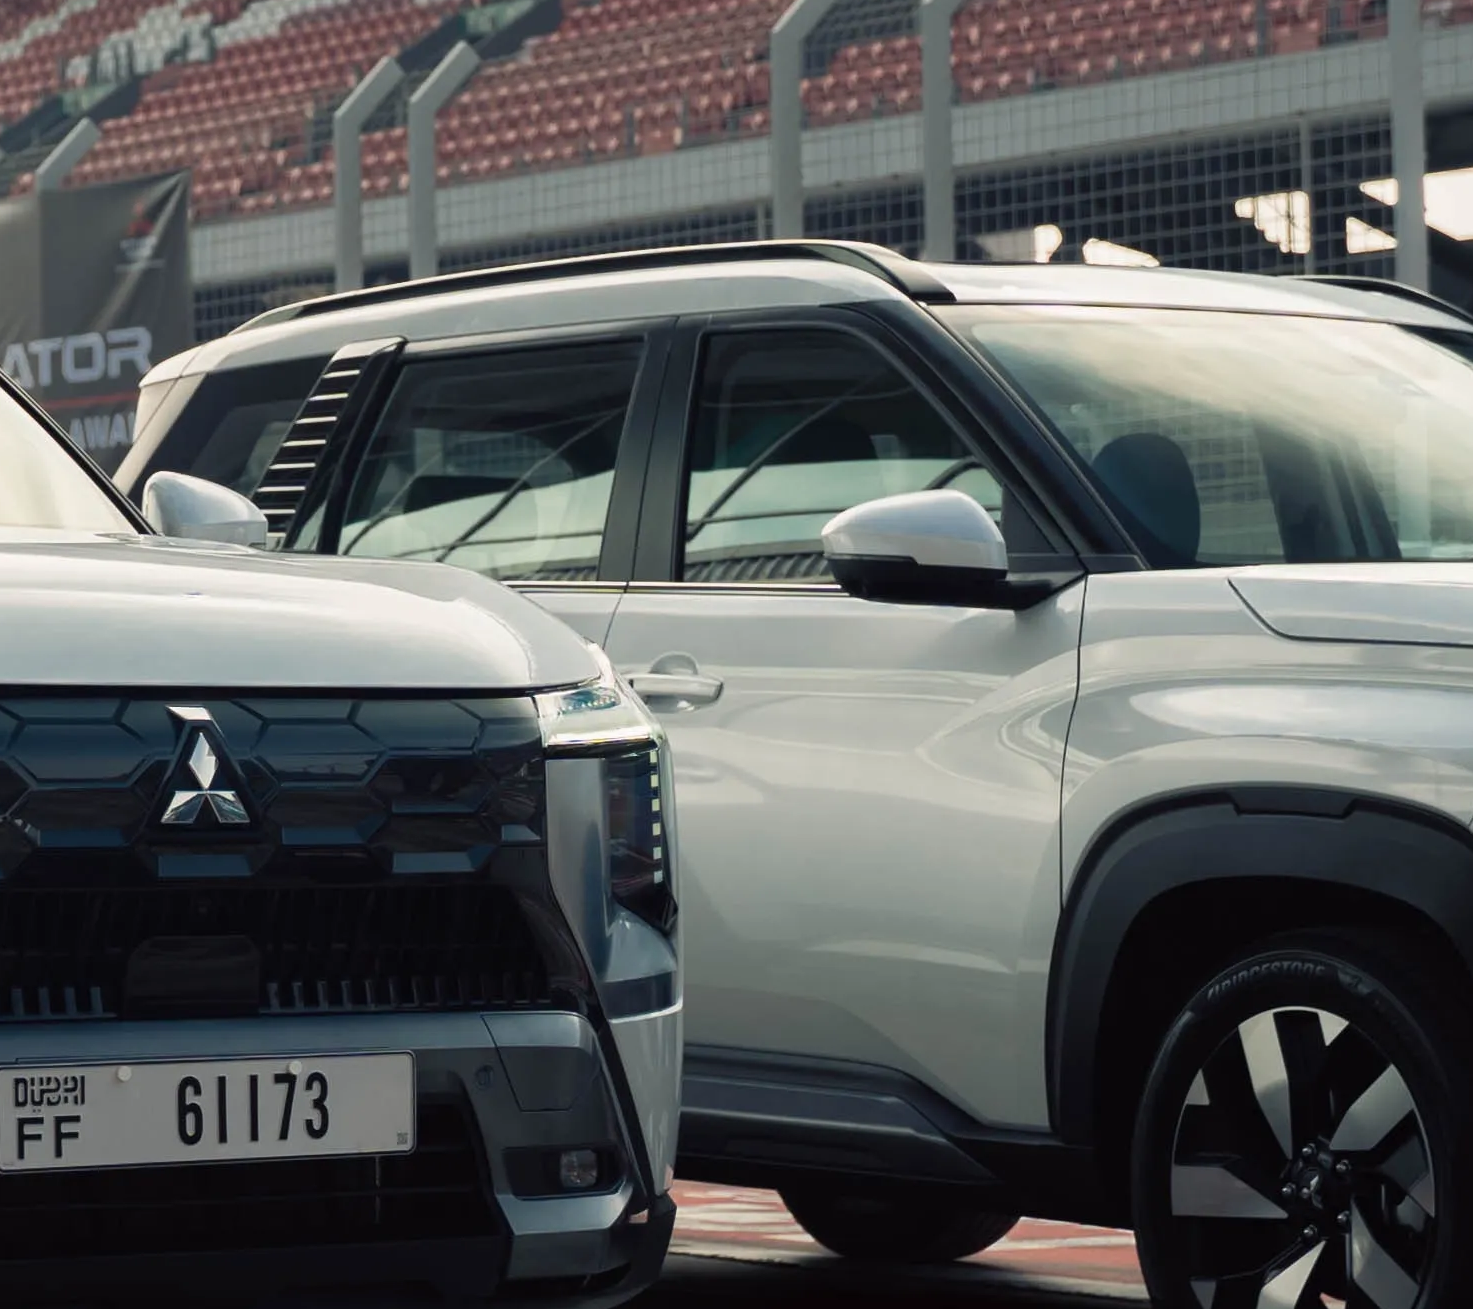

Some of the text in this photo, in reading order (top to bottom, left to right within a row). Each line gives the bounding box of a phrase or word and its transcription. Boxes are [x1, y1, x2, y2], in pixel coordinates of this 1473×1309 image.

[69, 411, 135, 450] AWA
[176, 1071, 330, 1146] 61173
[16, 1115, 82, 1160] FF
